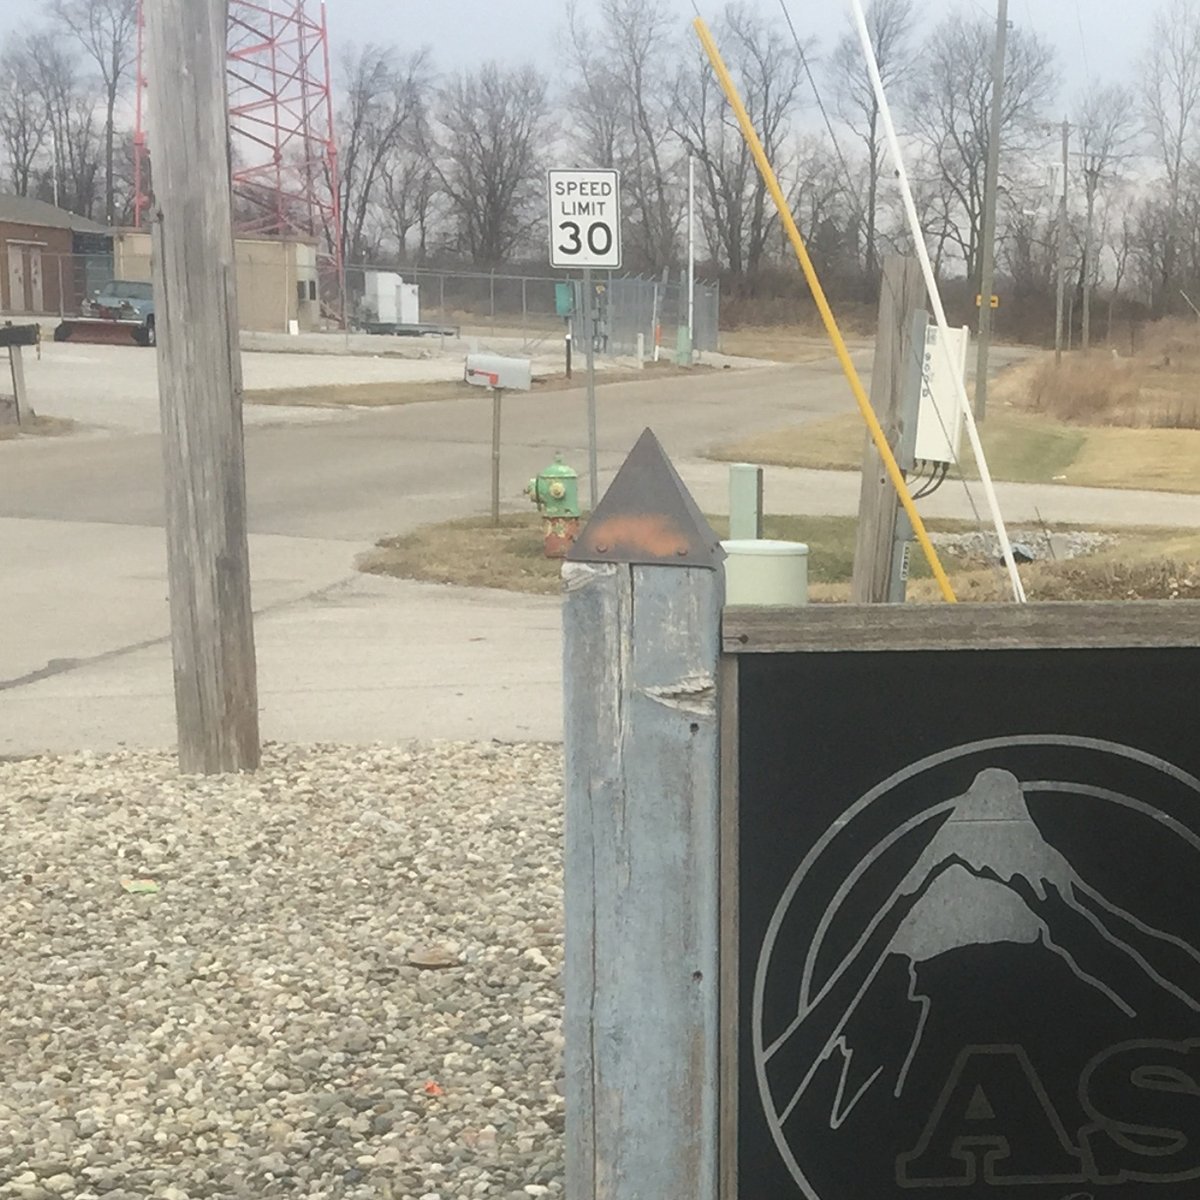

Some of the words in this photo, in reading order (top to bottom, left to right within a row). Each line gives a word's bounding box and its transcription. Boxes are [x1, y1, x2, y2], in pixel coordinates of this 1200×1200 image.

[555, 181, 612, 196] SPEED
[561, 201, 606, 216] LIMIT
[558, 221, 612, 256] 30
